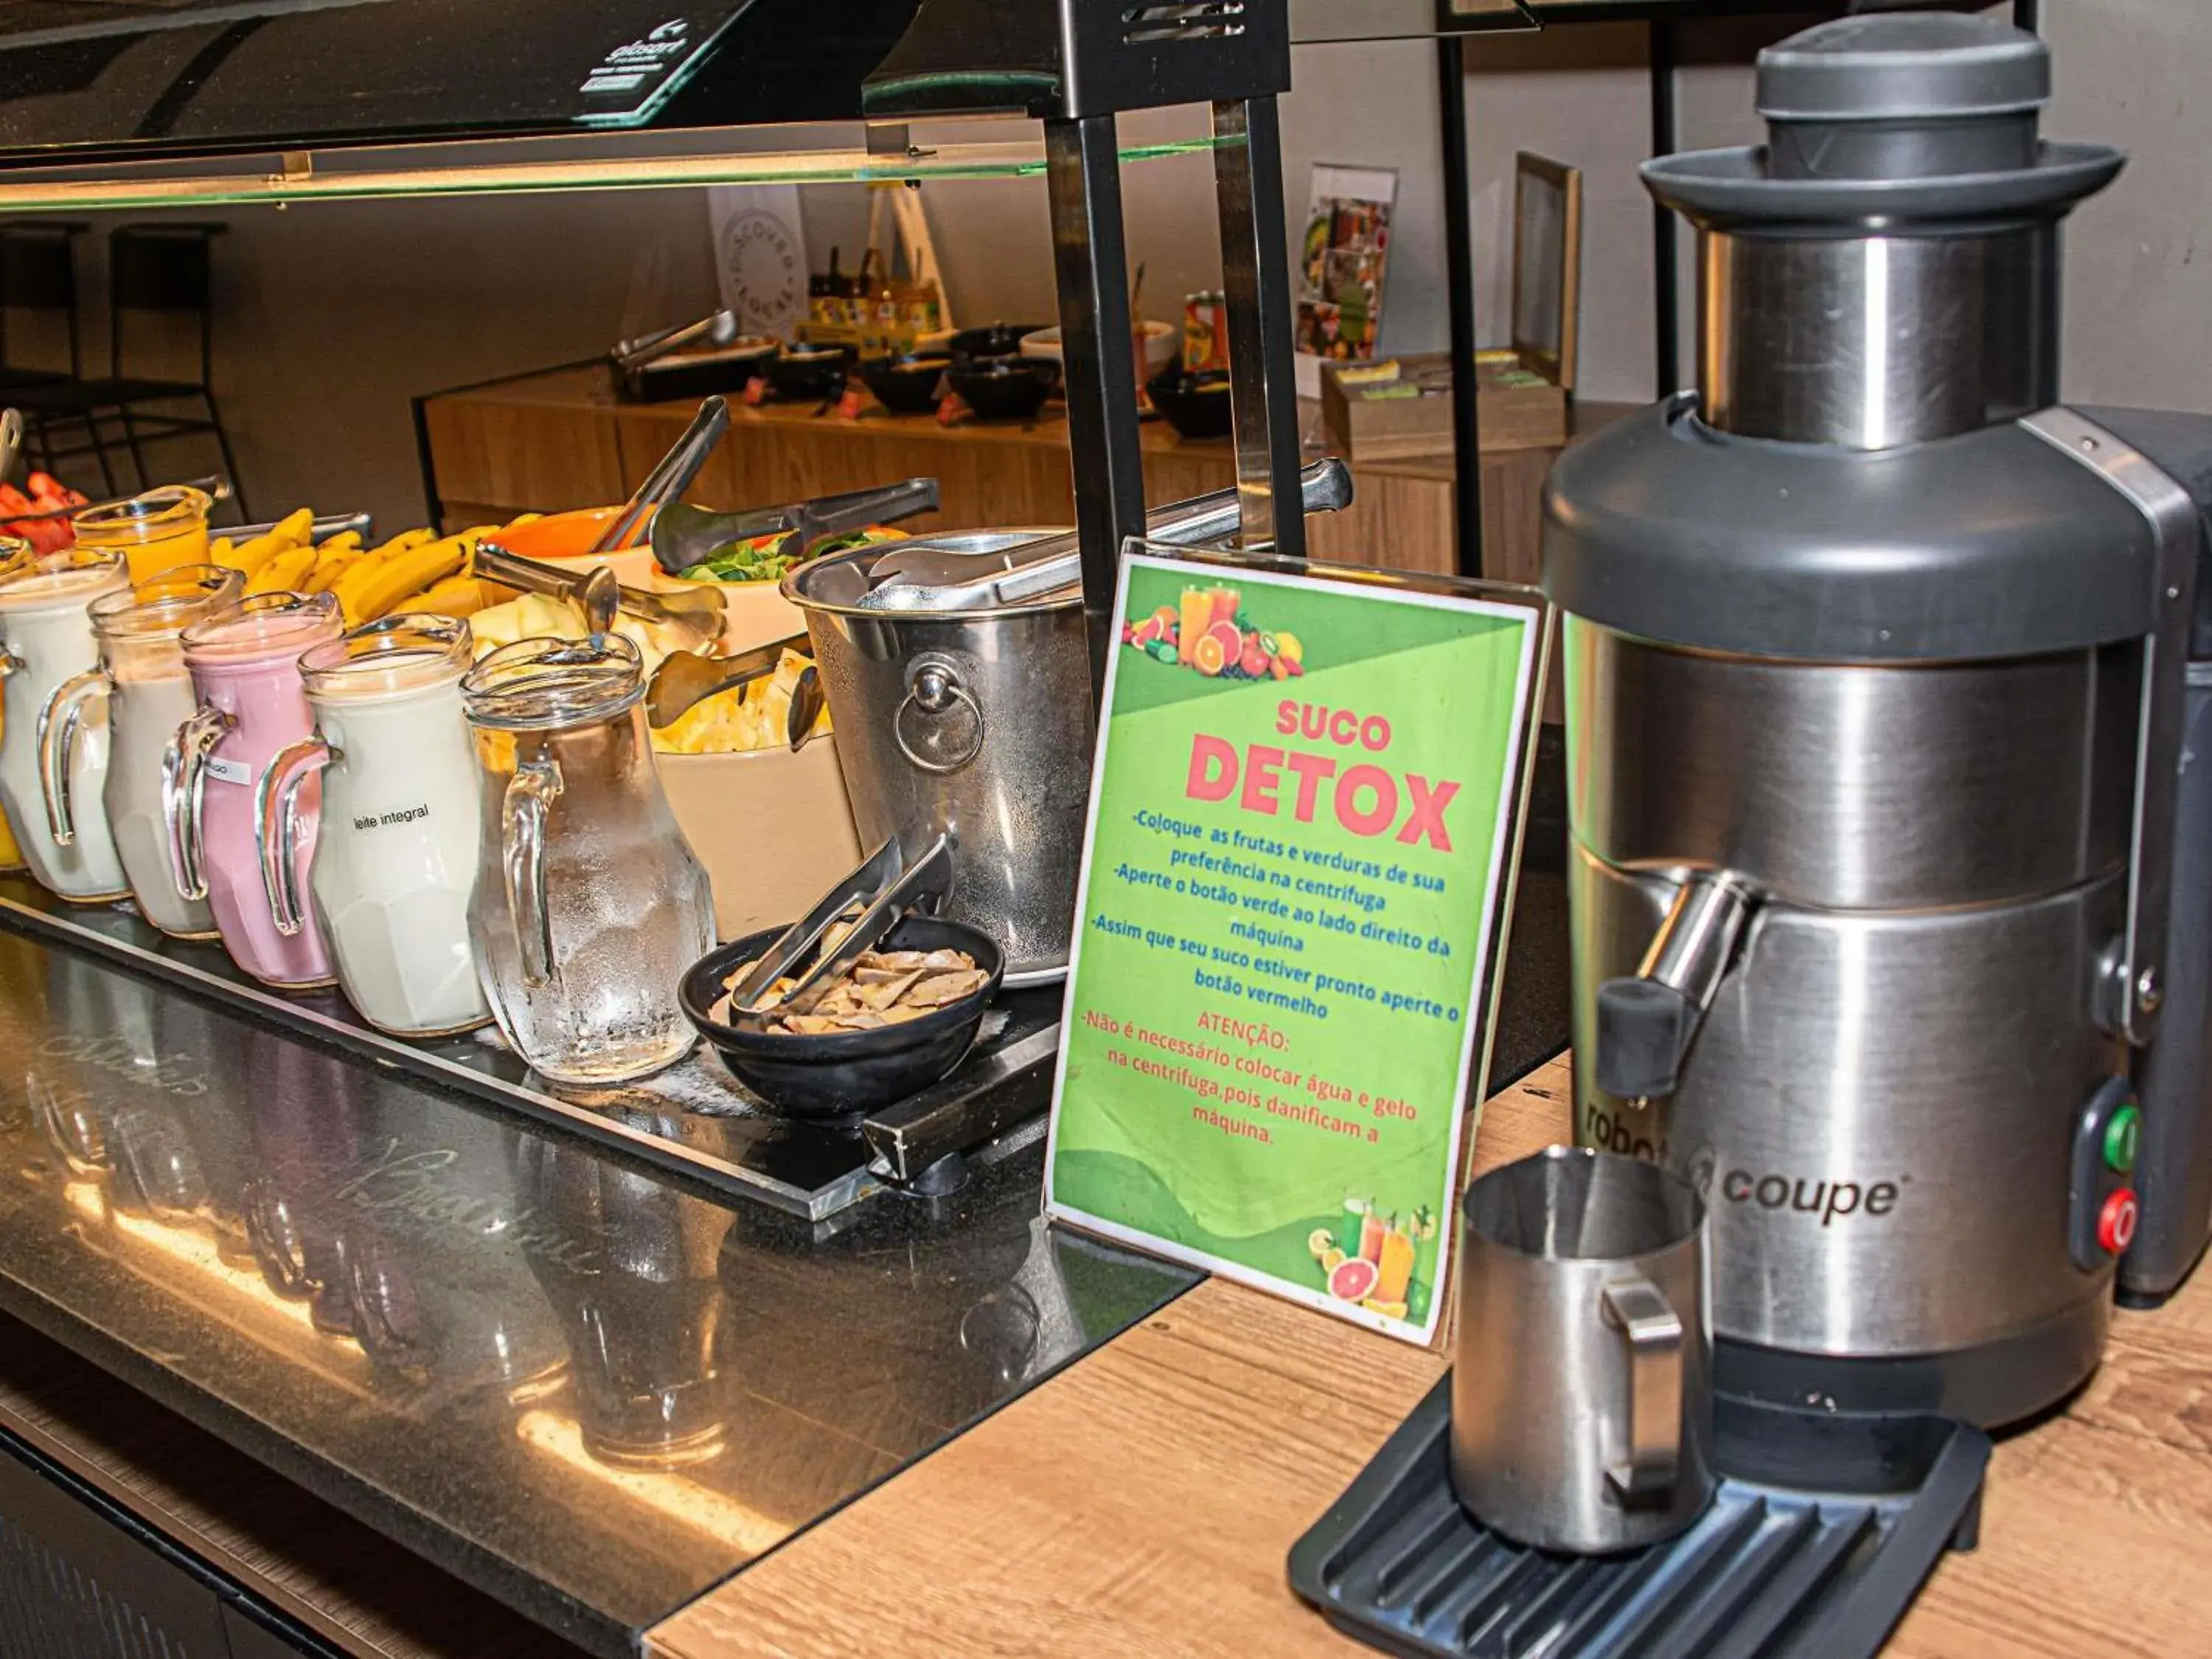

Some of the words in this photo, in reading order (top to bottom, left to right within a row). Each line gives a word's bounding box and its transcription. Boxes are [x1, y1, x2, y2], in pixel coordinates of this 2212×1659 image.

[1275, 700, 1391, 751] SUCO
[354, 816, 378, 830] leite
[380, 803, 429, 826] integral
[1185, 733, 1462, 853] DETOX
[1133, 809, 1203, 838] -Coloque
[1210, 828, 1228, 844] as
[1233, 830, 1284, 857] frutas
[1288, 846, 1298, 860] e
[1303, 851, 1381, 878] verduras
[1385, 863, 1408, 884] de
[1412, 873, 1446, 892] sua
[1170, 849, 1266, 883] preferência
[1270, 872, 1292, 888] na
[1113, 863, 1172, 889] -Aperte
[1175, 880, 1186, 893] o
[1189, 876, 1238, 905] botão
[1242, 895, 1290, 918] verde
[1293, 907, 1315, 923] ao
[1318, 908, 1356, 934] lado
[1360, 921, 1422, 950] direito
[1427, 936, 1450, 956] da
[1230, 920, 1304, 952] máquina
[1091, 914, 1141, 940] -Assim
[1146, 929, 1175, 949] que
[1180, 937, 1207, 957] seu
[1211, 946, 1250, 968] suco
[1253, 956, 1312, 984] estiver
[1315, 973, 1377, 1001] pronto
[1380, 990, 1443, 1018] aperte
[1448, 1006, 1459, 1022] o
[1194, 967, 1242, 996] botão
[1247, 985, 1328, 1019] vermelho
[1081, 1009, 1119, 1034] -Não
[1124, 1020, 1134, 1039] é
[1138, 1027, 1230, 1067] necessário
[1235, 1055, 1301, 1087] colocar
[1307, 1074, 1352, 1101] água
[1358, 1091, 1369, 1107] e
[1372, 1099, 1416, 1120] gelo
[1198, 1012, 1290, 1052] ATENÇÃO:
[1107, 1048, 1128, 1067] na
[1266, 1096, 1361, 1138] danificam
[1366, 1127, 1379, 1143] a
